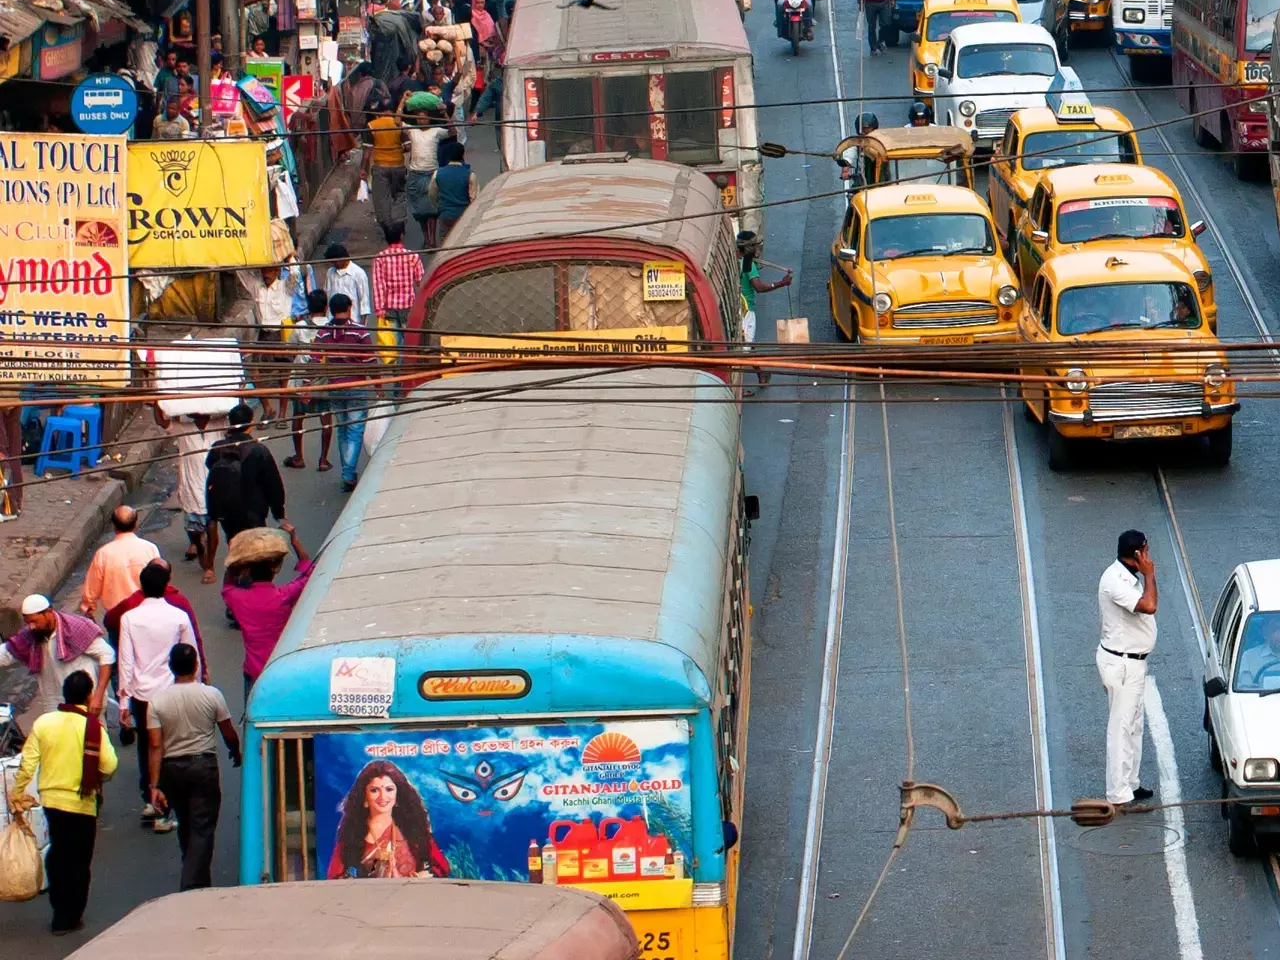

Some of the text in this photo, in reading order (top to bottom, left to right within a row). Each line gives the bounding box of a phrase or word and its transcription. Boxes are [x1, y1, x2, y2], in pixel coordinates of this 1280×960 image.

[594, 51, 659, 61] C.S.T.C.
[79, 111, 130, 120] BUSES ONLY
[1066, 105, 1087, 114] TAXI
[33, 141, 120, 172] TOUCH
[57, 182, 80, 207] (P)
[87, 181, 120, 207] Ltd.
[1094, 199, 1145, 207] KRISHNA
[153, 228, 248, 240] SCHOOL UNIFORM
[33, 311, 88, 328] WEAR
[95, 313, 107, 328] &
[543, 343, 575, 355] Dream
[579, 342, 609, 354] House
[635, 334, 667, 352] Sika
[49, 372, 87, 381] KOLKATA
[431, 676, 516, 693] Welcome
[331, 693, 392, 704] 9339869682
[331, 704, 388, 715] 983606302
[366, 741, 418, 757] শারদীয়ার
[422, 738, 450, 756] প্রীতি
[456, 743, 467, 753] ও
[471, 738, 516, 754] শুভেচ্ছা
[550, 737, 580, 750] করুন
[582, 762, 641, 772] GITANJALI UDYOG
[599, 771, 625, 779] GROUP
[542, 778, 683, 796] GITANJALI GOLD
[562, 795, 590, 807] Kachhi
[591, 794, 617, 806] Ghani
